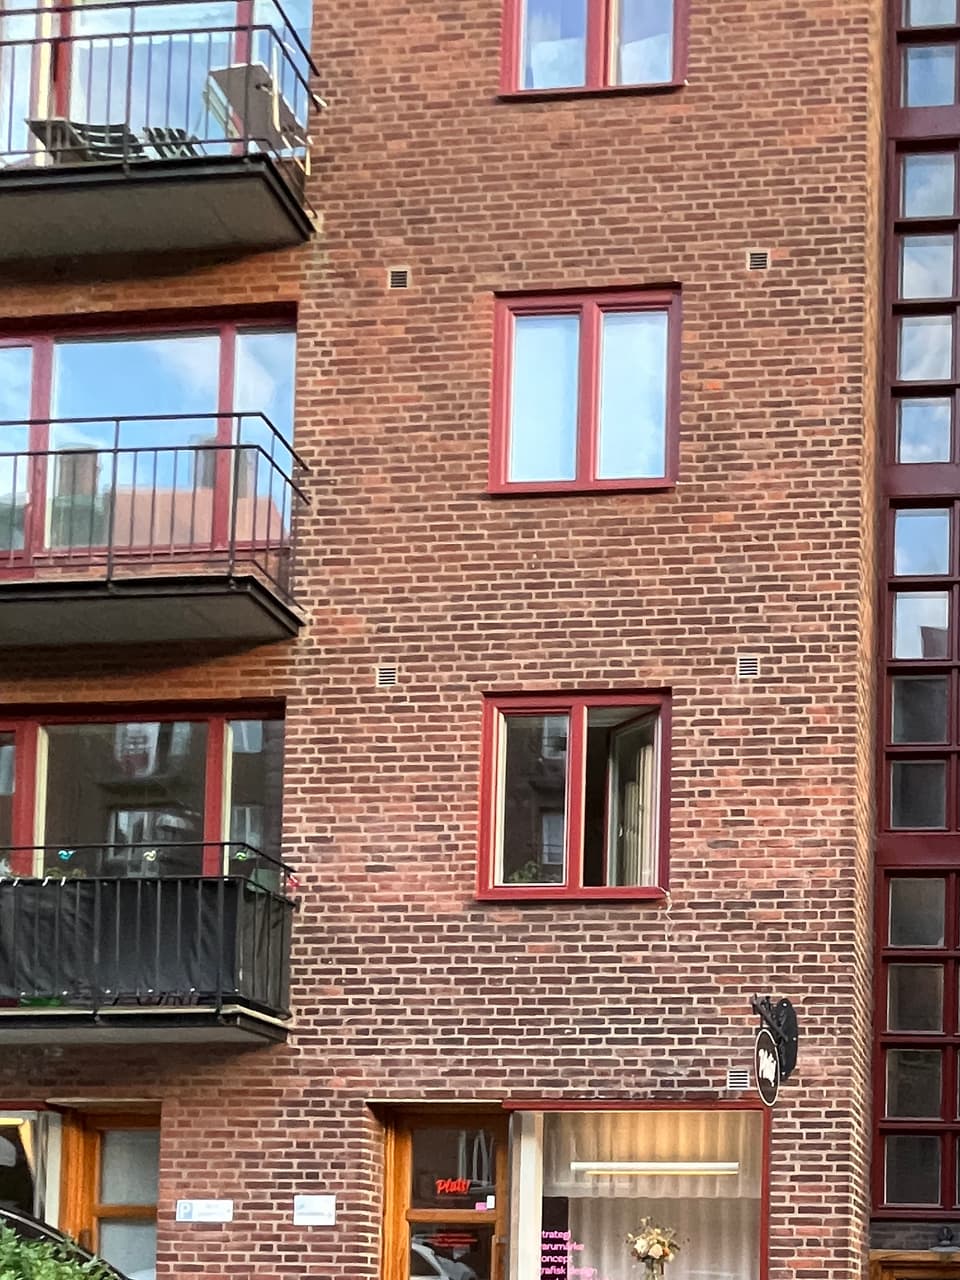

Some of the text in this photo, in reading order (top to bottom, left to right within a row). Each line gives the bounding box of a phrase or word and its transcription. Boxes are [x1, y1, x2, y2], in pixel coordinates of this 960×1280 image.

[180, 1203, 192, 1218] P
[541, 1229, 571, 1241] trategi
[540, 1241, 585, 1251] arumärke
[540, 1254, 573, 1265] oncept
[540, 1265, 566, 1275] rafisk
